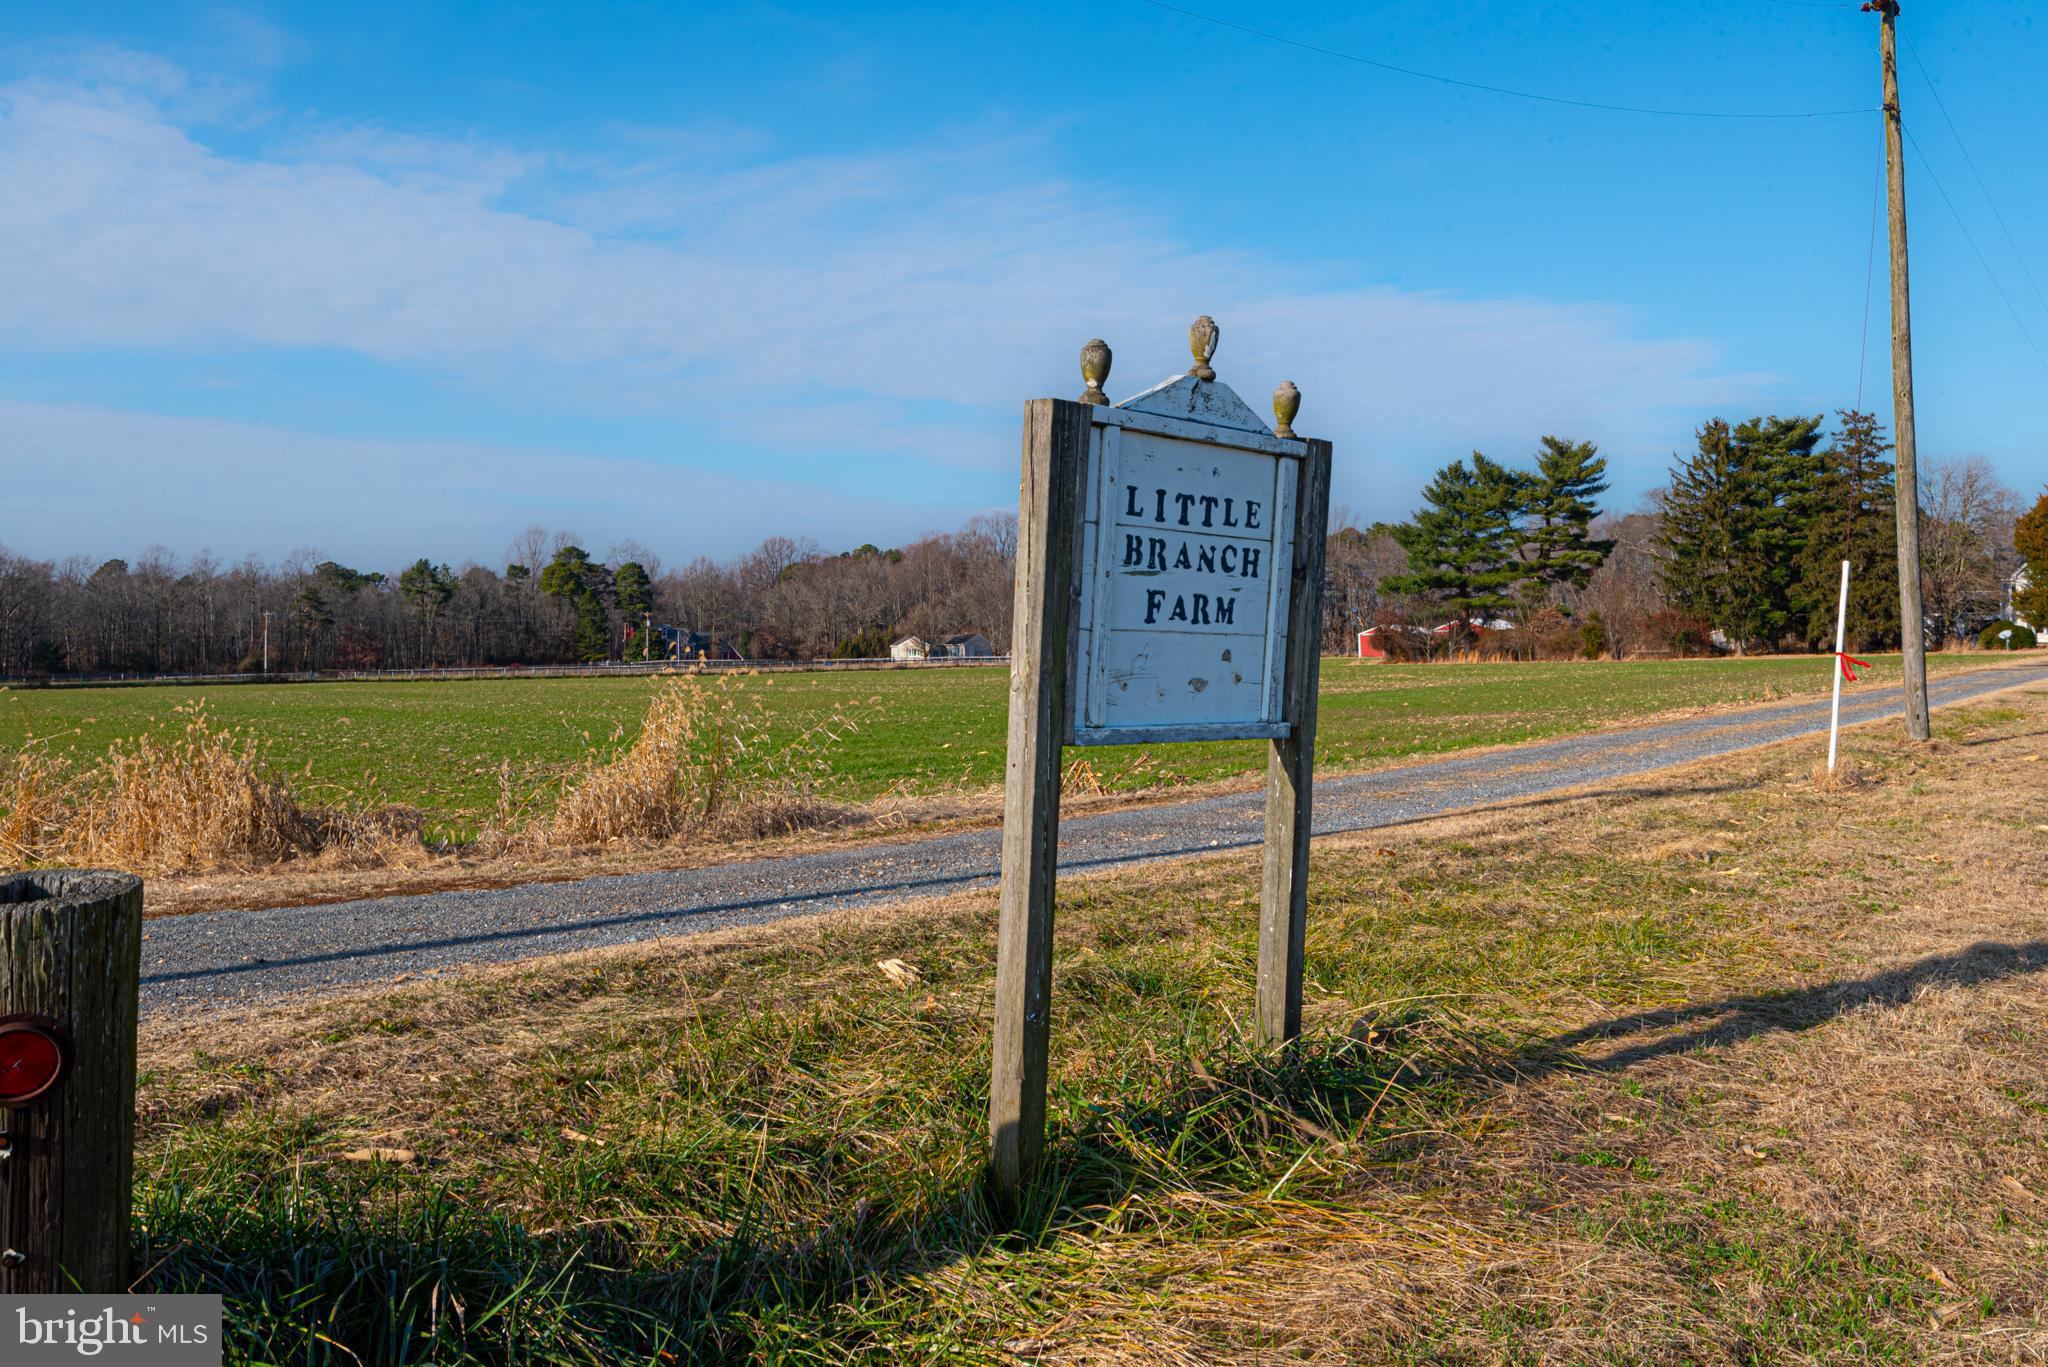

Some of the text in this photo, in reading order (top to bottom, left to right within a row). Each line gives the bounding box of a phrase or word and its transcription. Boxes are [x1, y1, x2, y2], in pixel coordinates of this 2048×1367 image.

[1125, 485, 1261, 529] LITTLE
[1123, 534, 1261, 578] BRANCH
[1144, 589, 1236, 625] FARM
